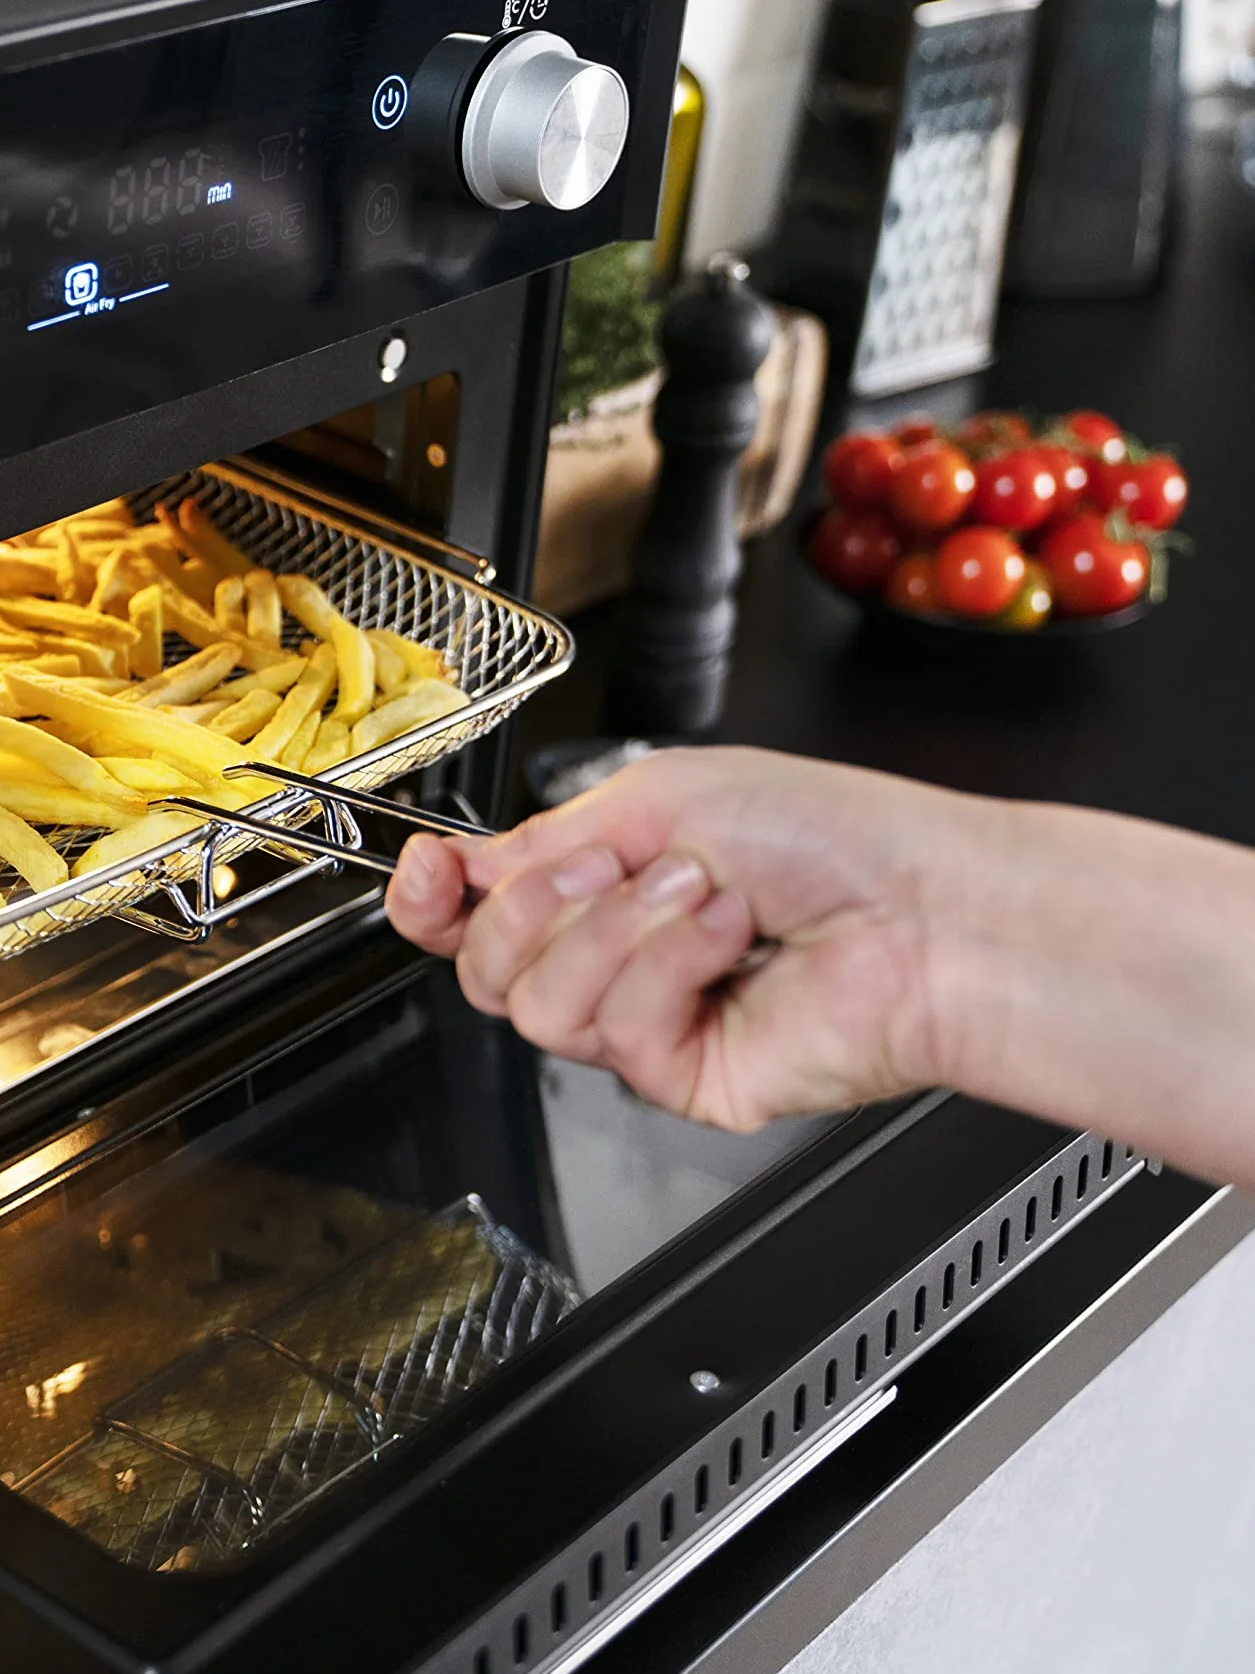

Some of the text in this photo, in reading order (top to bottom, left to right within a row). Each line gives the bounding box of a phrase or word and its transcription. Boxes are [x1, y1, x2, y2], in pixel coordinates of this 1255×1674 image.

[207, 182, 232, 205] min
[84, 297, 115, 316] Air Fry
